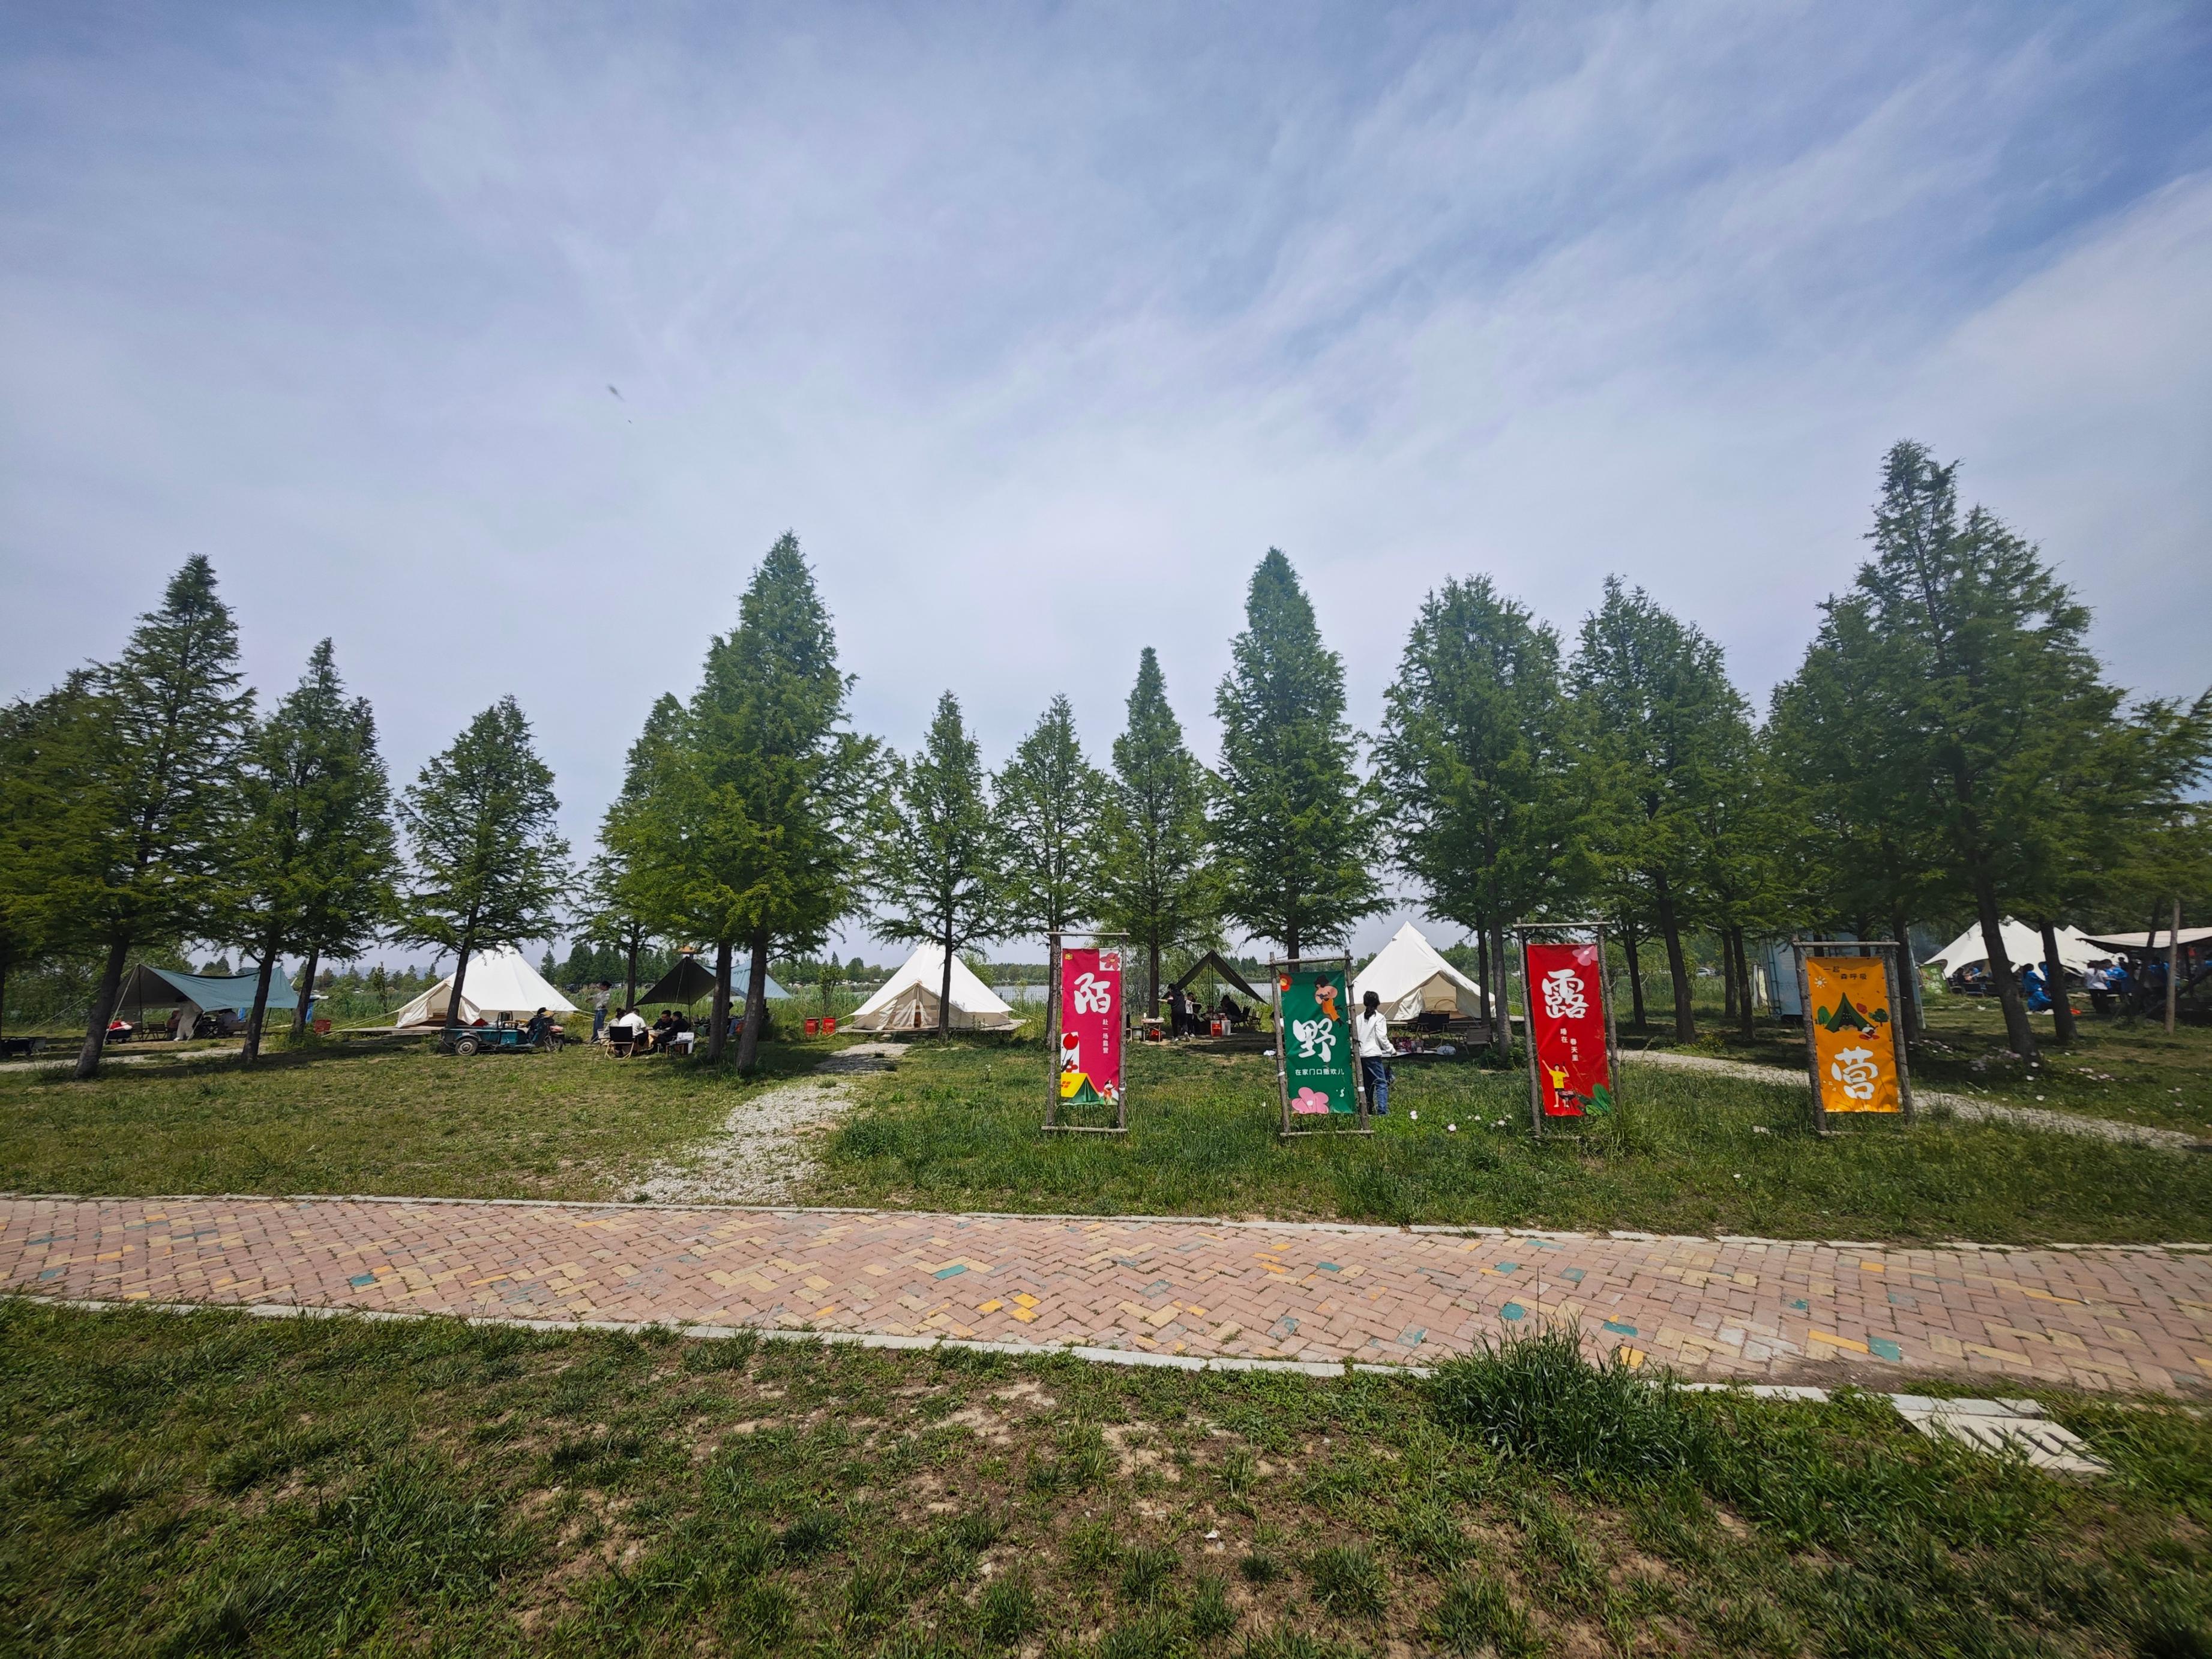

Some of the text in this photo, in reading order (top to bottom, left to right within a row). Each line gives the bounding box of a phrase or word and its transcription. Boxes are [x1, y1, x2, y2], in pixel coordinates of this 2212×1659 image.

[1074, 972, 1111, 1014] 陌
[1542, 969, 1589, 1019] 露
[1293, 1018, 1336, 1062] 野
[1570, 1038, 1579, 1061] 春天里
[1295, 1068, 1345, 1076] 在家门口撒欢儿
[1832, 1046, 1878, 1100] 营
